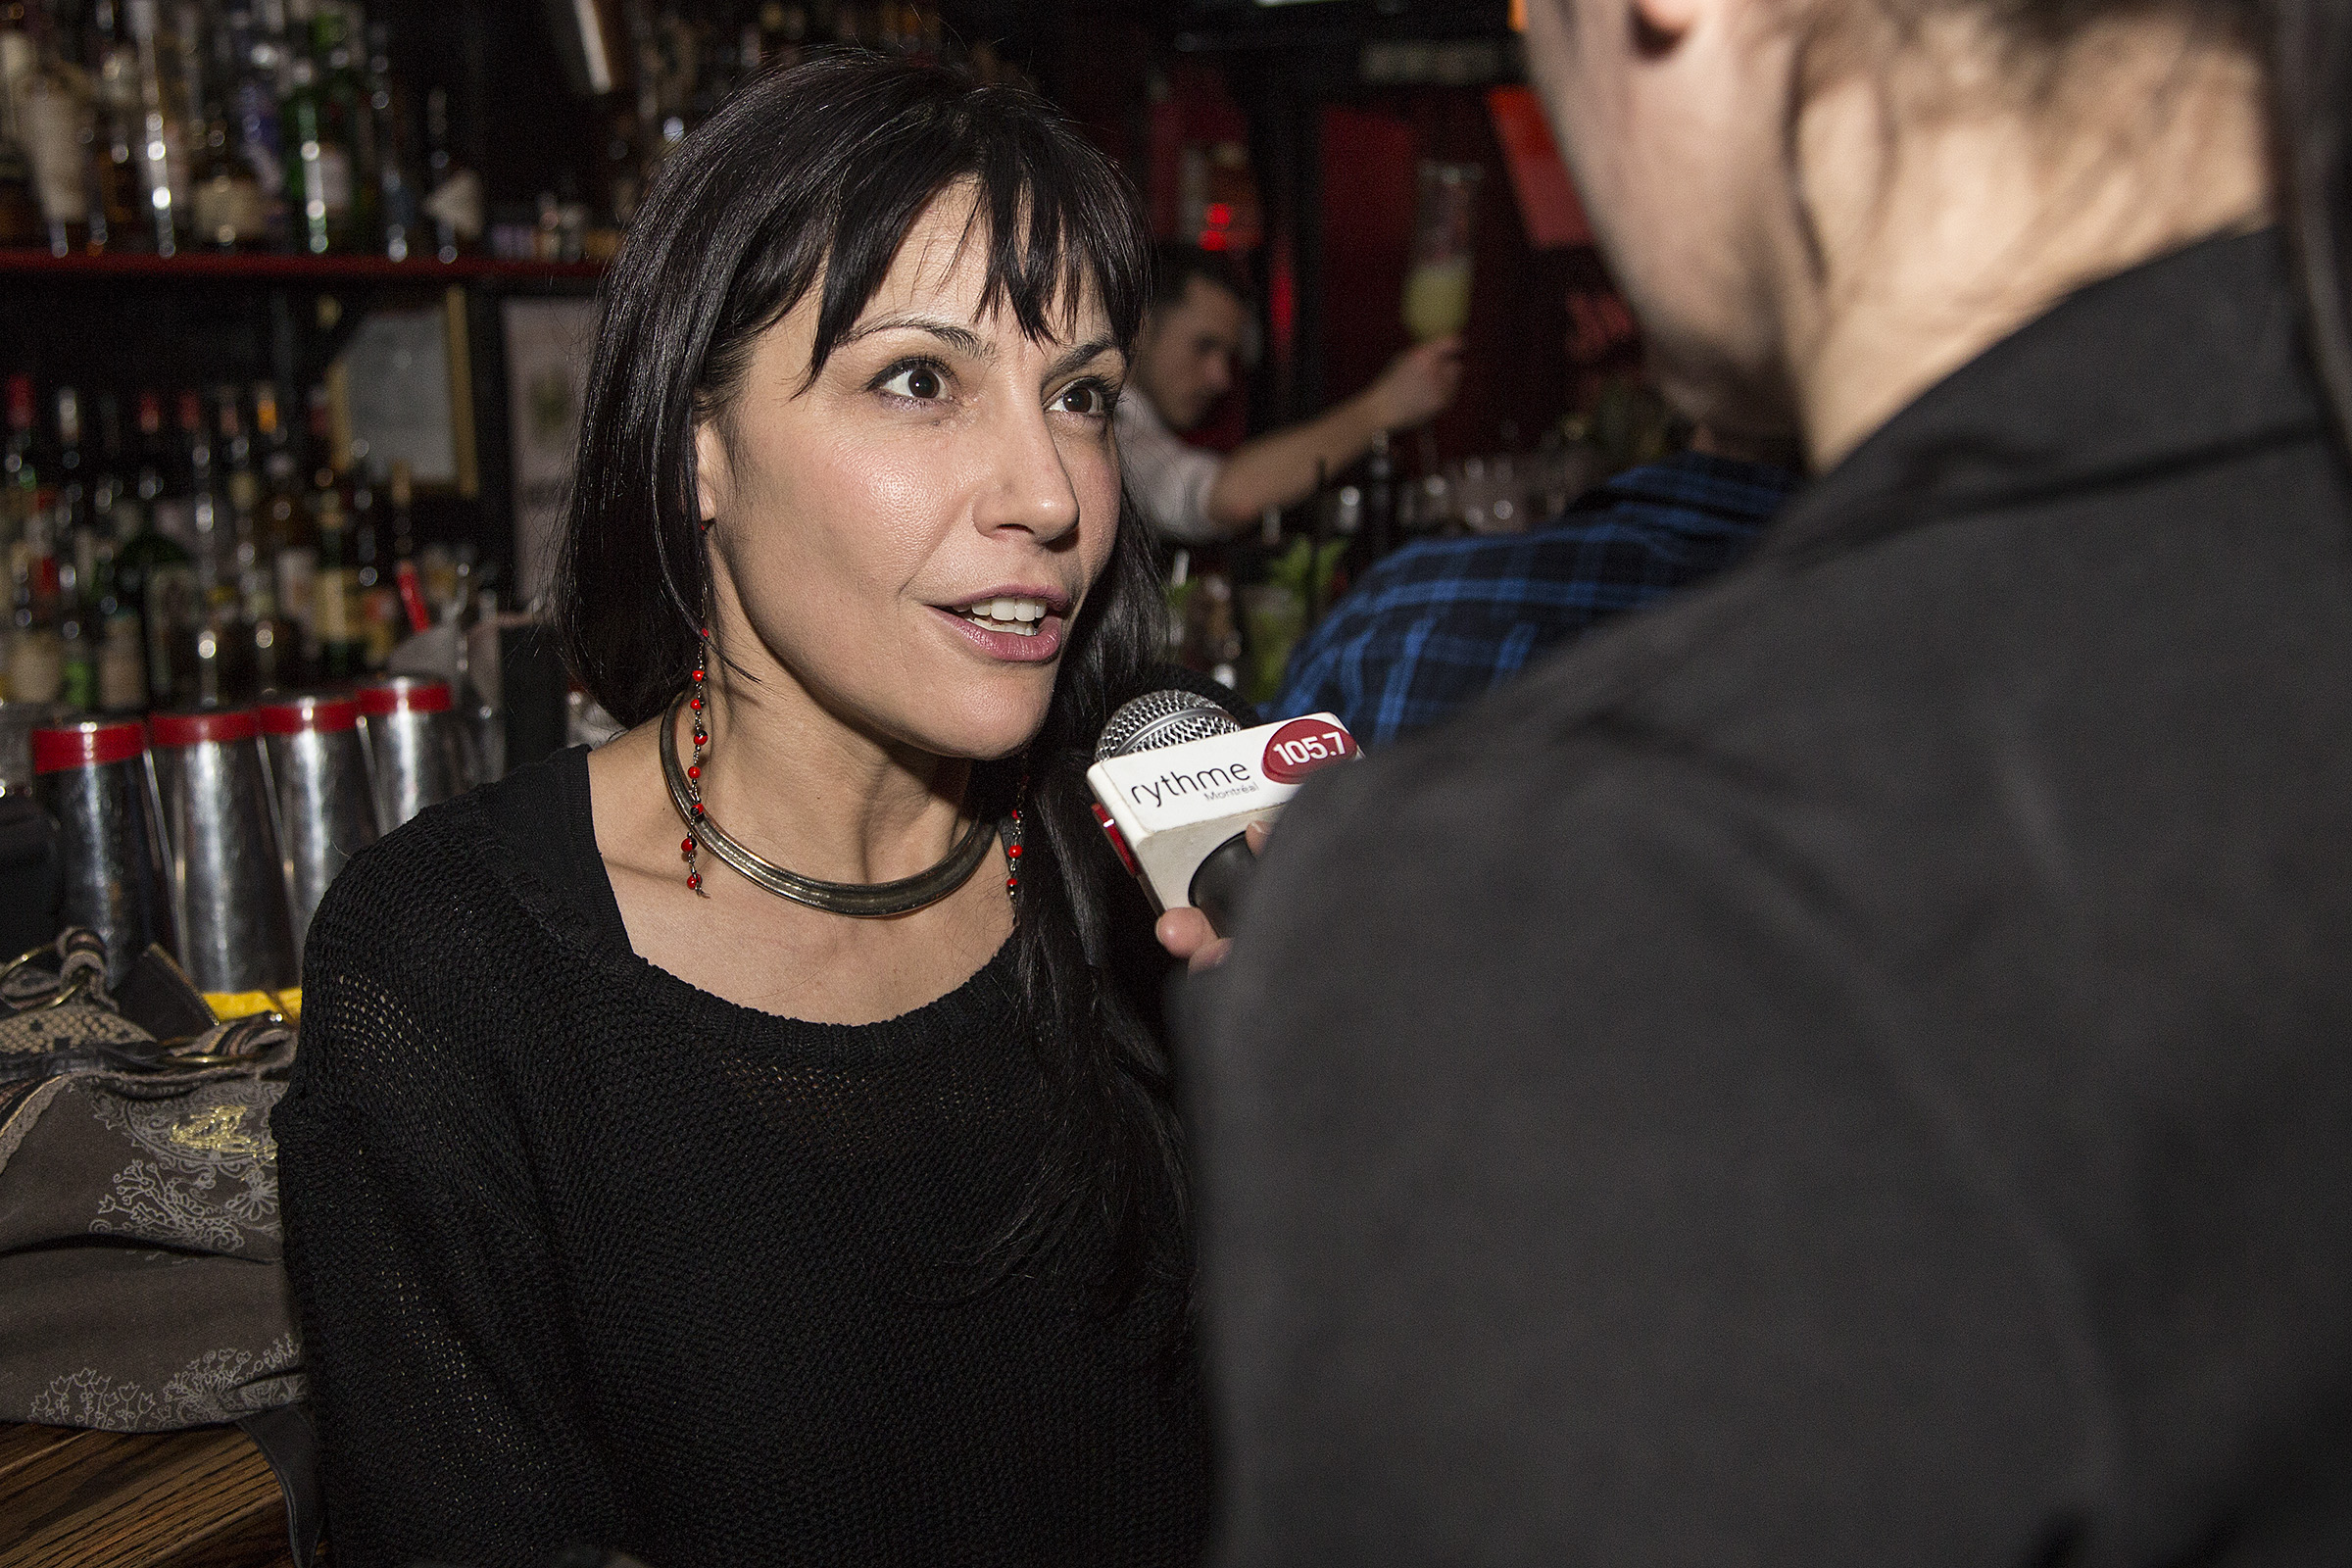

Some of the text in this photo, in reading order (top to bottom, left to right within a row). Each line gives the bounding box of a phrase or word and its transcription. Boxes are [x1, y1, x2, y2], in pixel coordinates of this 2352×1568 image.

[1274, 732, 1347, 766] 105.7
[1131, 762, 1250, 808] rythme
[1204, 781, 1259, 802] Montréal
